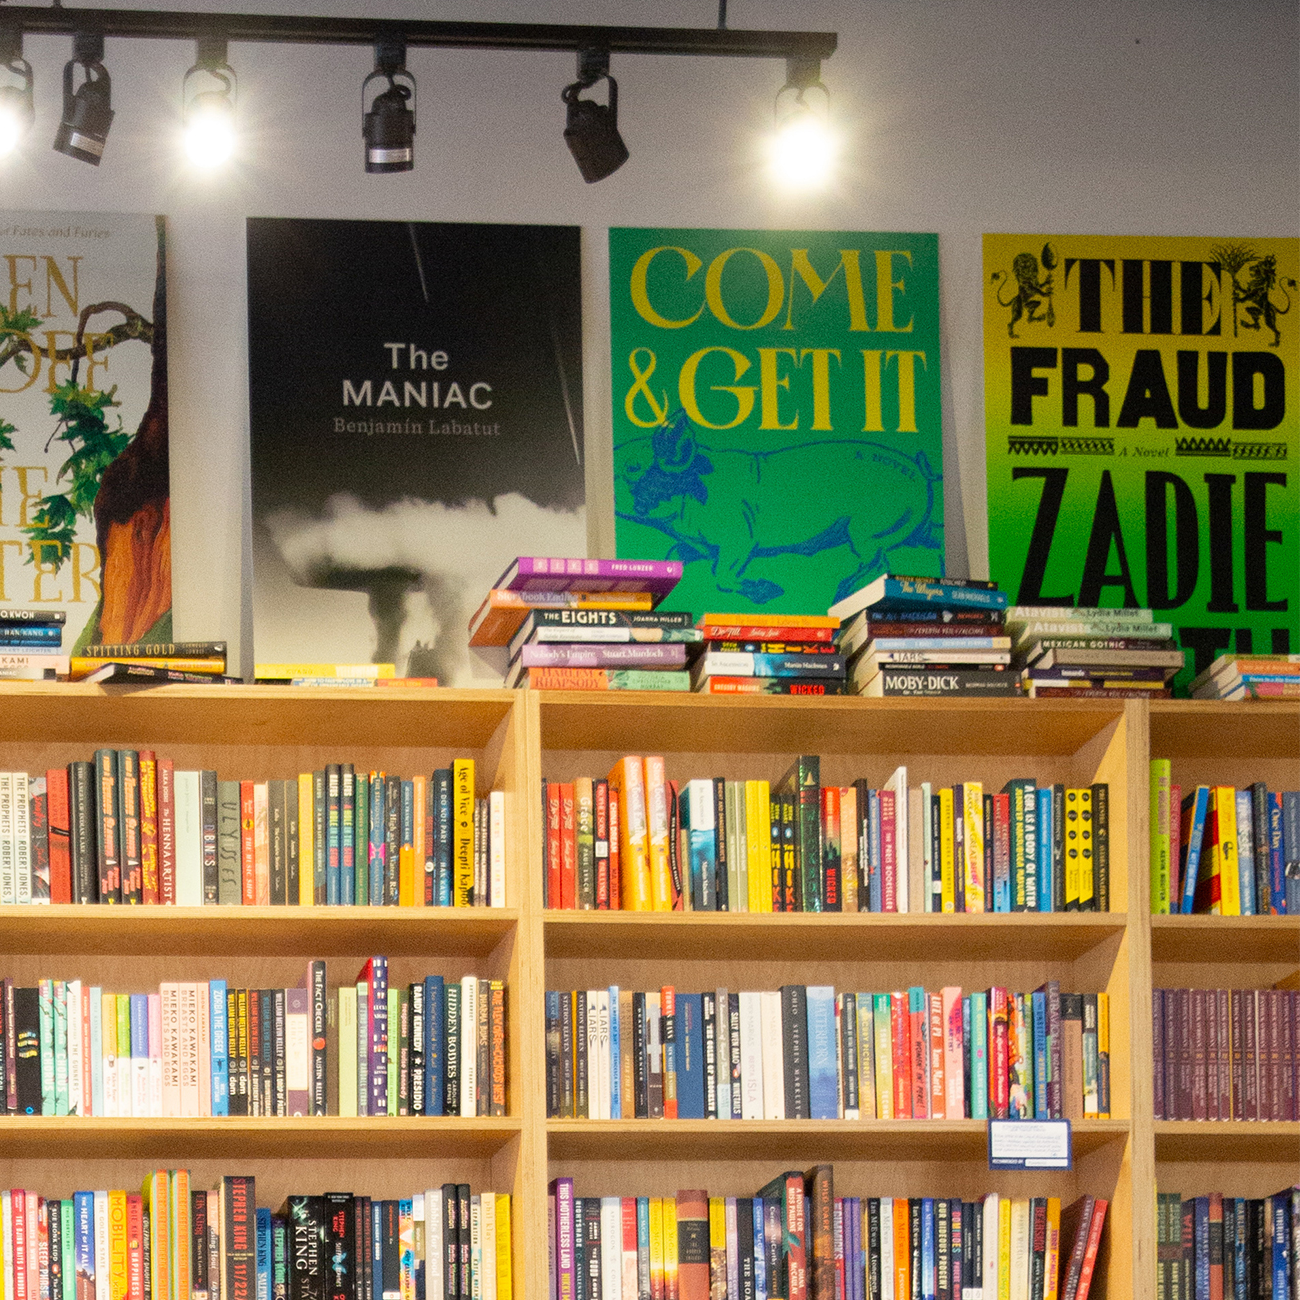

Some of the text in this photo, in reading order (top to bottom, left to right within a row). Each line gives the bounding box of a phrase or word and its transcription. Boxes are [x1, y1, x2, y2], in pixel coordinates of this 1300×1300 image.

[630, 246, 914, 332] COME
[1064, 258, 1222, 336] THE
[384, 343, 449, 370] The
[343, 379, 493, 409] MANIAC
[625, 346, 927, 432] & GET IT
[1010, 346, 1285, 430] FRAUD
[429, 419, 501, 436] Labatut
[1132, 446, 1170, 458] Novel
[1012, 467, 1288, 613] ZADIE
[544, 612, 617, 625] THE EIGHTS
[86, 644, 175, 657] SPITTING GOLD
[885, 675, 959, 690] MOBY-DICK
[580, 797, 590, 831] Grace
[163, 819, 172, 898] HENNA ARTIST
[560, 1184, 569, 1199] THIS
[560, 1201, 570, 1246] MOTHERLESS
[295, 1226, 308, 1270] KING
[308, 1221, 318, 1275] STEPHEN
[561, 1248, 570, 1268] LAND
[561, 1273, 570, 1291] NIKKI
